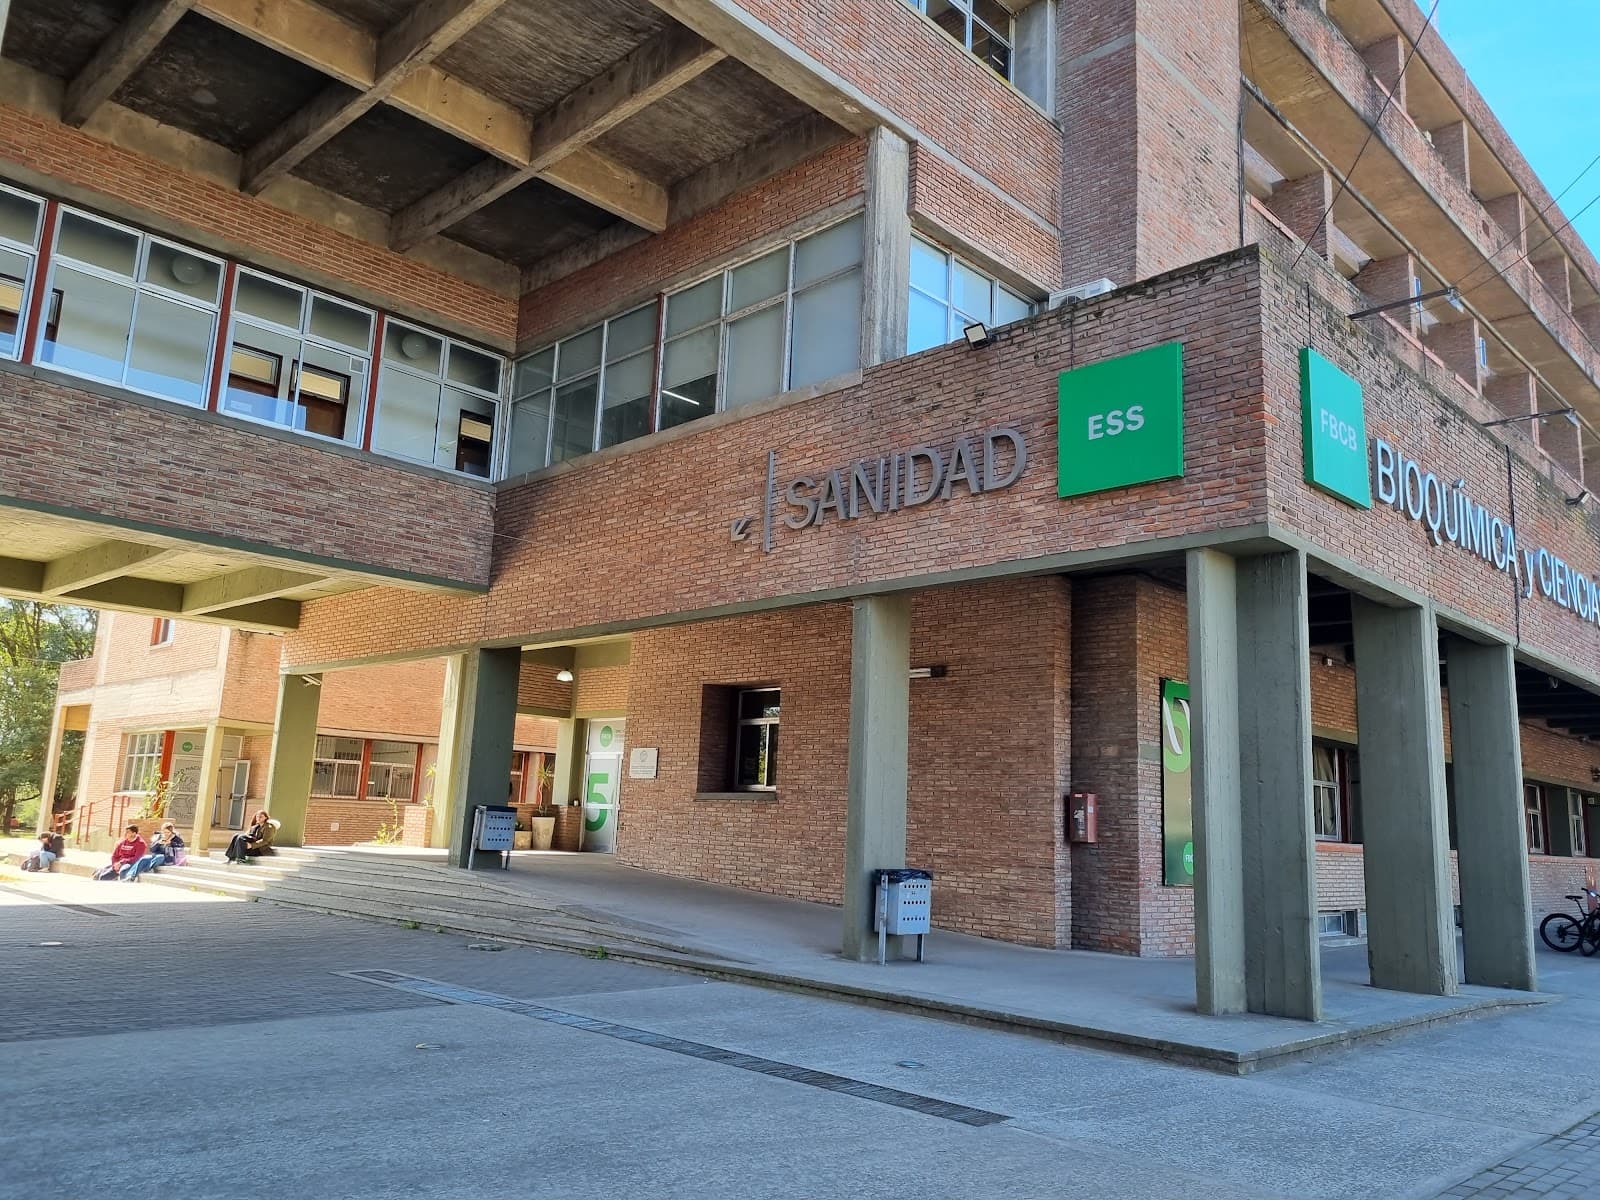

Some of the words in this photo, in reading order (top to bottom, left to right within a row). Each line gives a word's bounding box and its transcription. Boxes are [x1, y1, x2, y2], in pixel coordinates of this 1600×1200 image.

[1088, 405, 1145, 440] ESS
[1320, 408, 1357, 451] FBCB
[784, 428, 1027, 530] SANIDAD
[1374, 438, 1518, 578] BIOQUÍMICA
[1538, 547, 1600, 627] CIENCIA
[585, 773, 609, 832] 5
